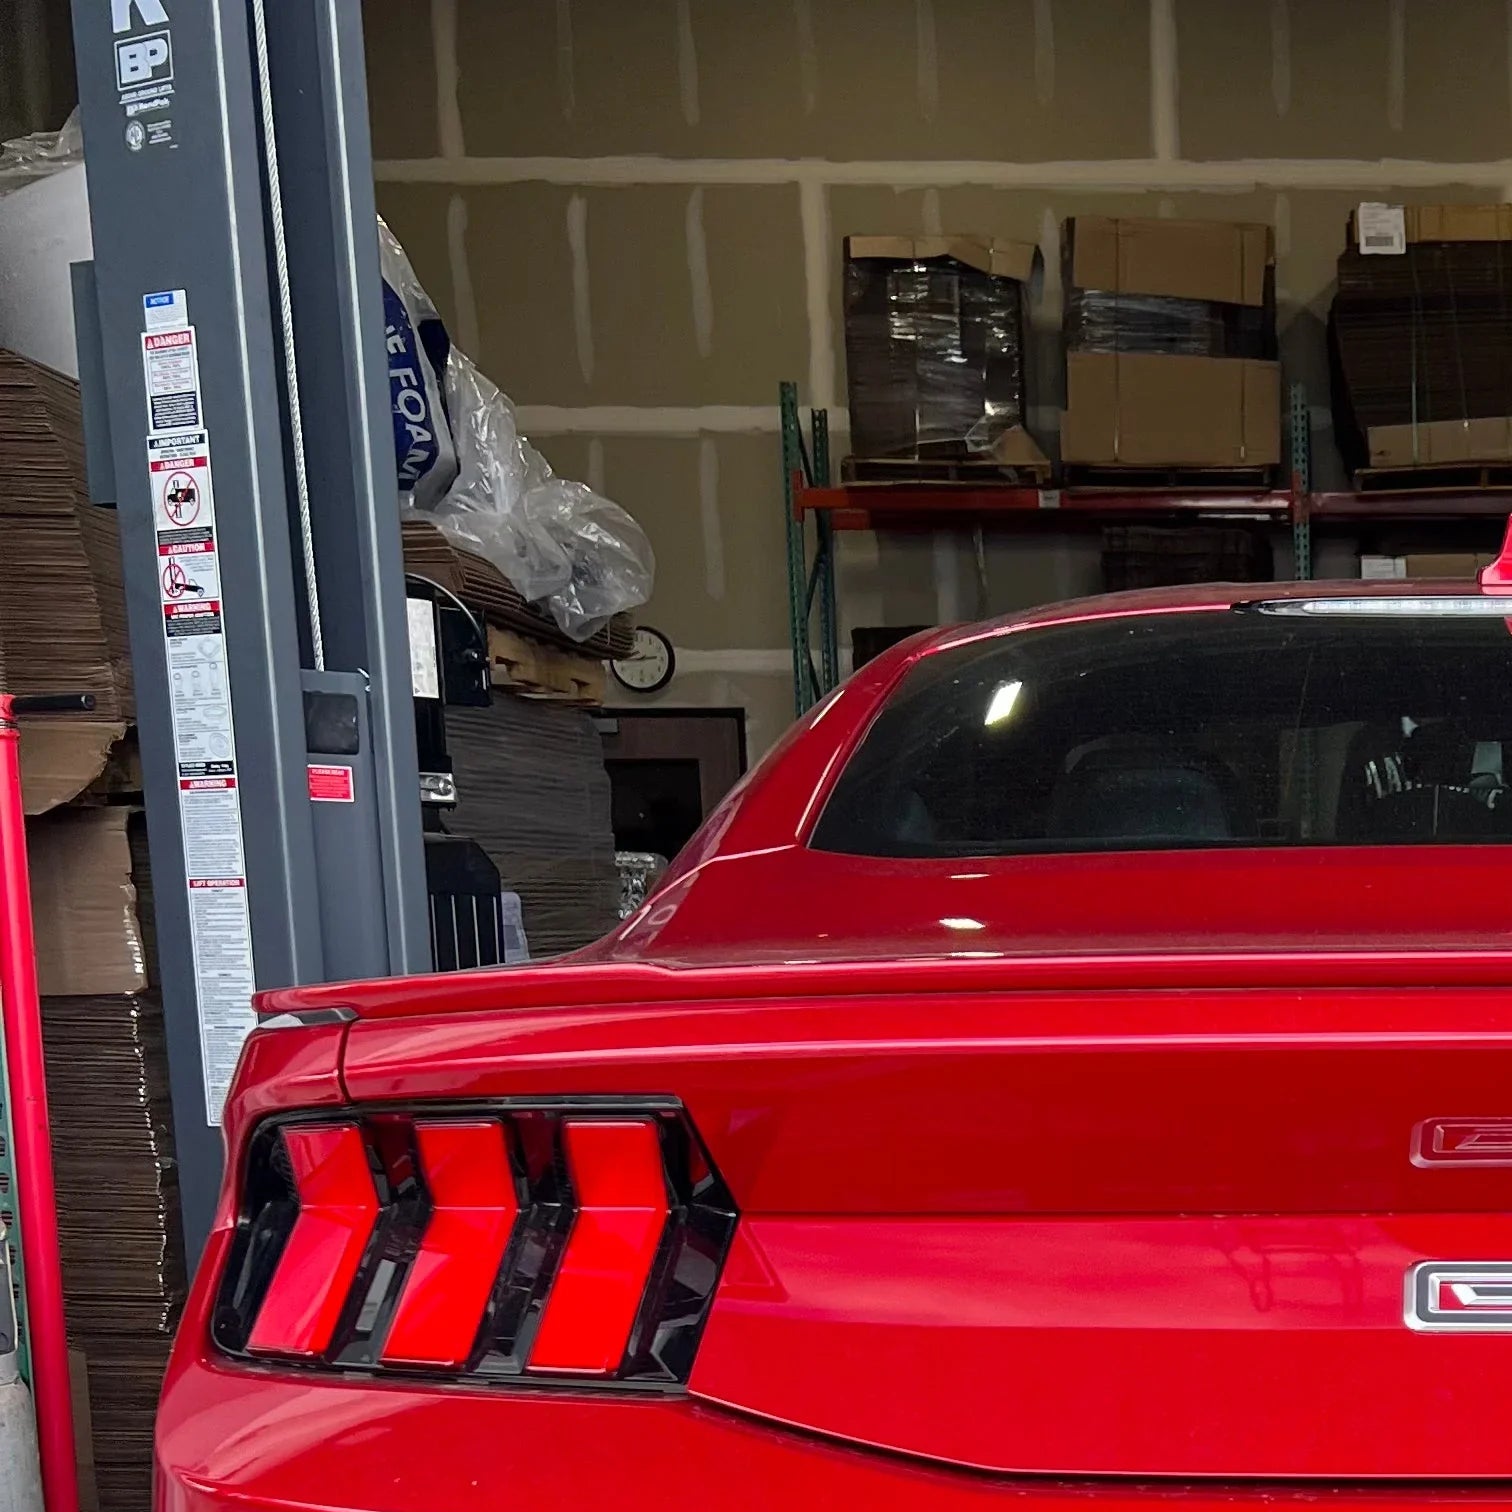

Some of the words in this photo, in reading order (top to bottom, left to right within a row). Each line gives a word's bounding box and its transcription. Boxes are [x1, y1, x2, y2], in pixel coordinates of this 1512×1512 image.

[119, 37, 169, 84] BP
[153, 332, 190, 348] DANGER
[389, 367, 432, 480] FOAM
[158, 435, 200, 447] IMPORTANT
[163, 458, 195, 470] DANGER
[172, 542, 206, 554] CAUTION
